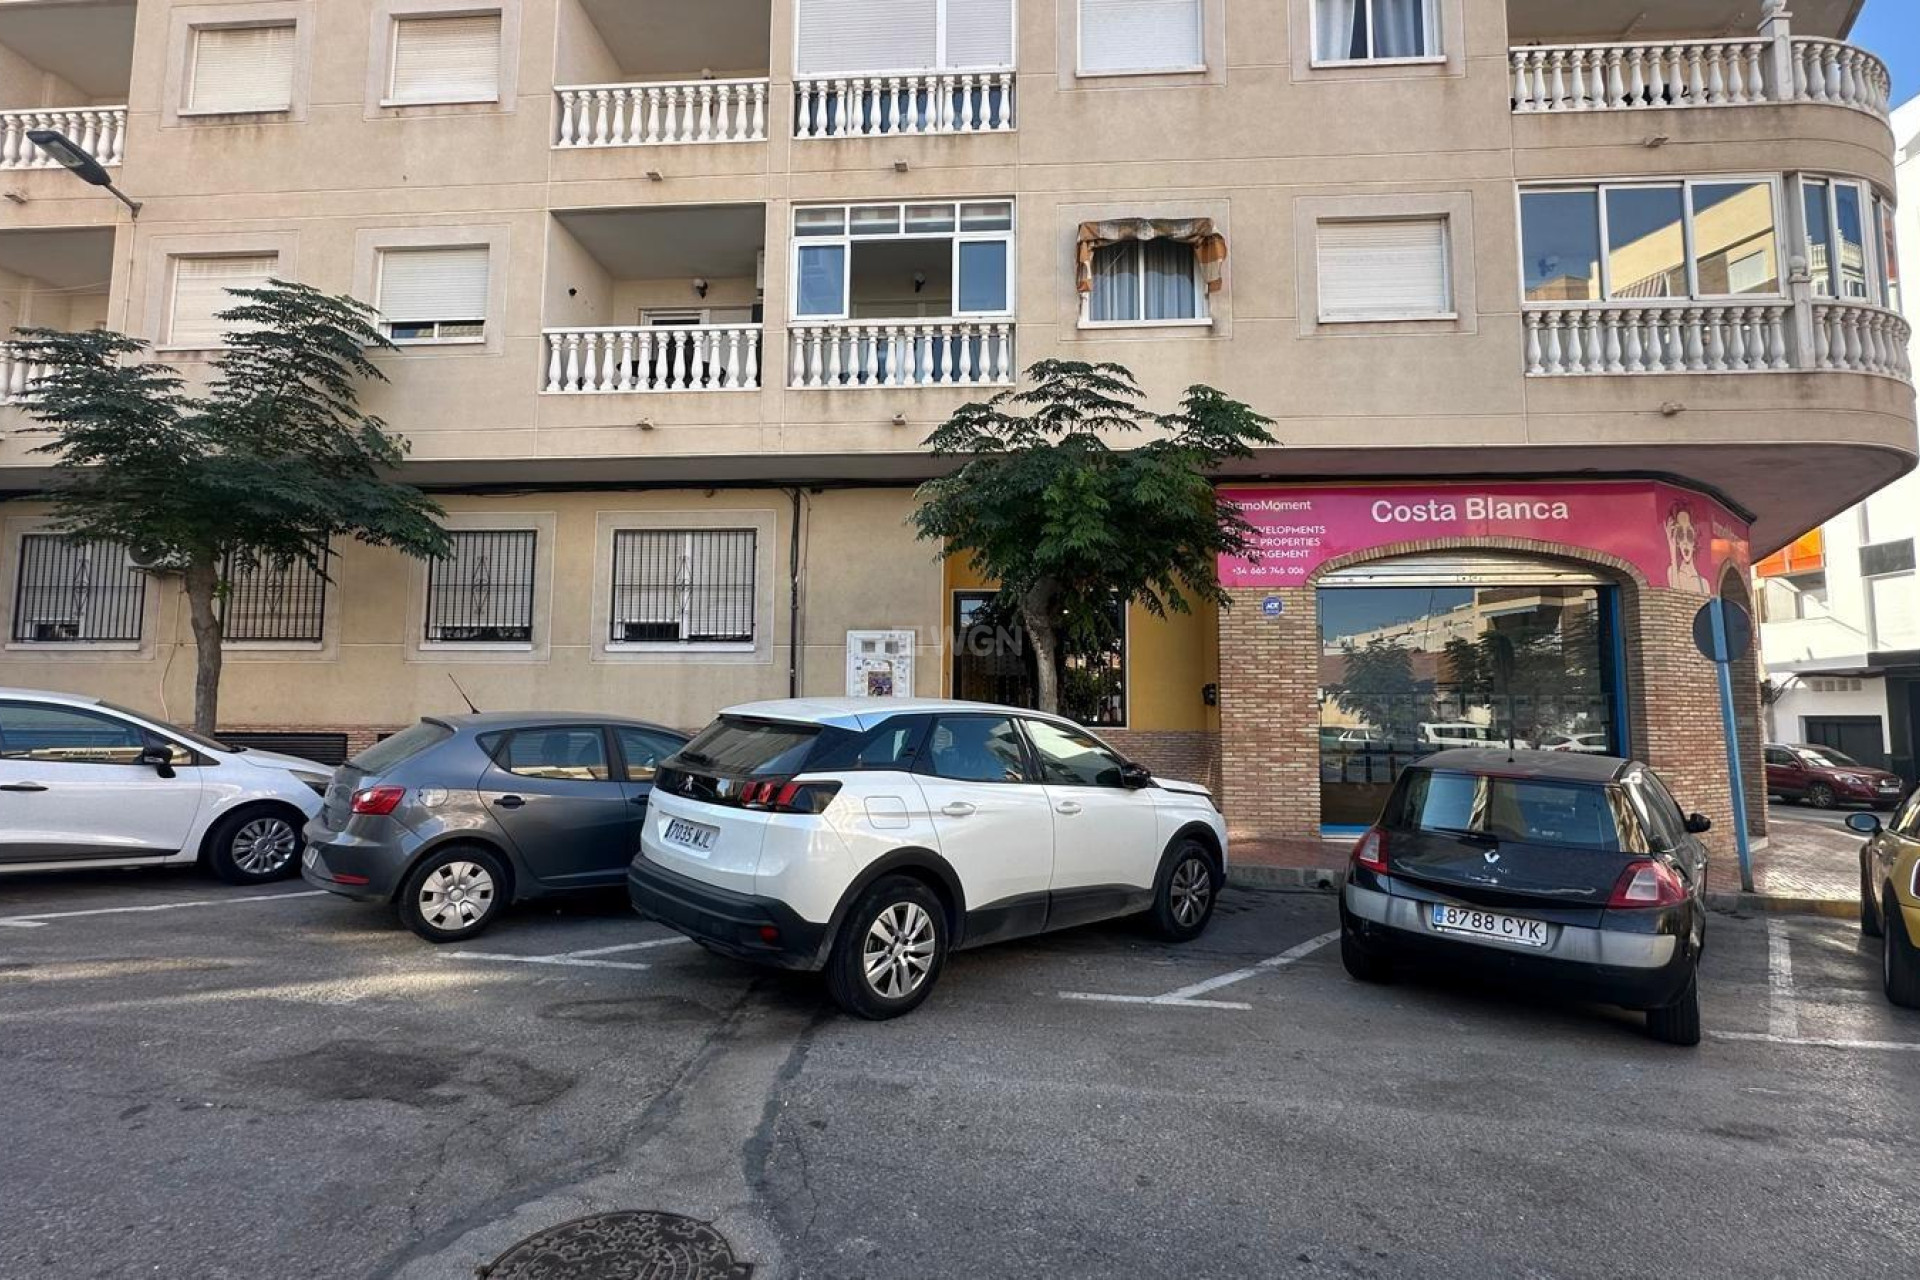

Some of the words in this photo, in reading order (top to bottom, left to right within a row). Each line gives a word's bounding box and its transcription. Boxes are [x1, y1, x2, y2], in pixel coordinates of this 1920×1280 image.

[1226, 500, 1312, 511] moMoment
[1371, 500, 1456, 523] Costa
[1465, 497, 1569, 520] Blanca
[1244, 526, 1326, 534] VELOPMENTS
[1260, 538, 1321, 547] PROPERTIES
[1446, 908, 1495, 931] 8788
[1501, 917, 1541, 940] CYK
